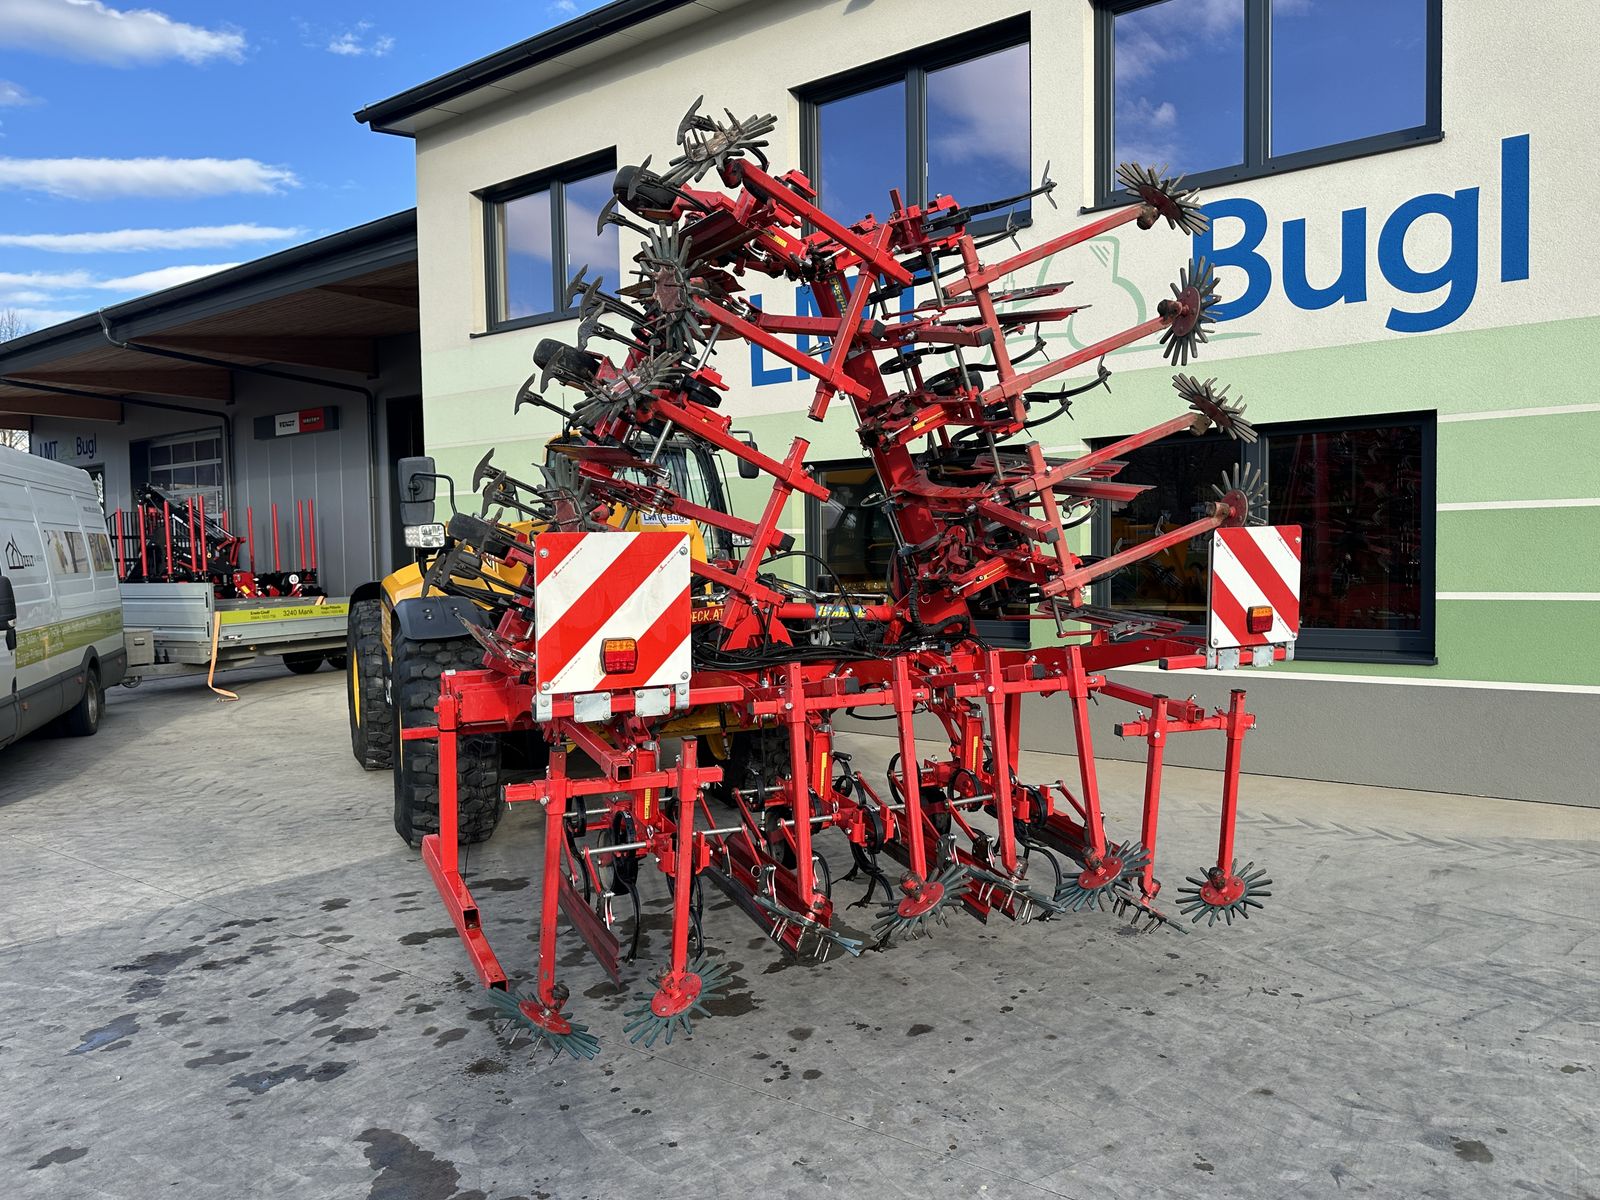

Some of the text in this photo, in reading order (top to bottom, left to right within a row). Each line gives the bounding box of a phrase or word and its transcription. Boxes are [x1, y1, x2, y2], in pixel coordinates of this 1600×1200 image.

[1193, 134, 1529, 333] Bugl
[76, 433, 97, 459] Bugl
[283, 609, 297, 617] 3240
[691, 608, 724, 623] ECK.AT
[818, 605, 866, 619] Einbk
